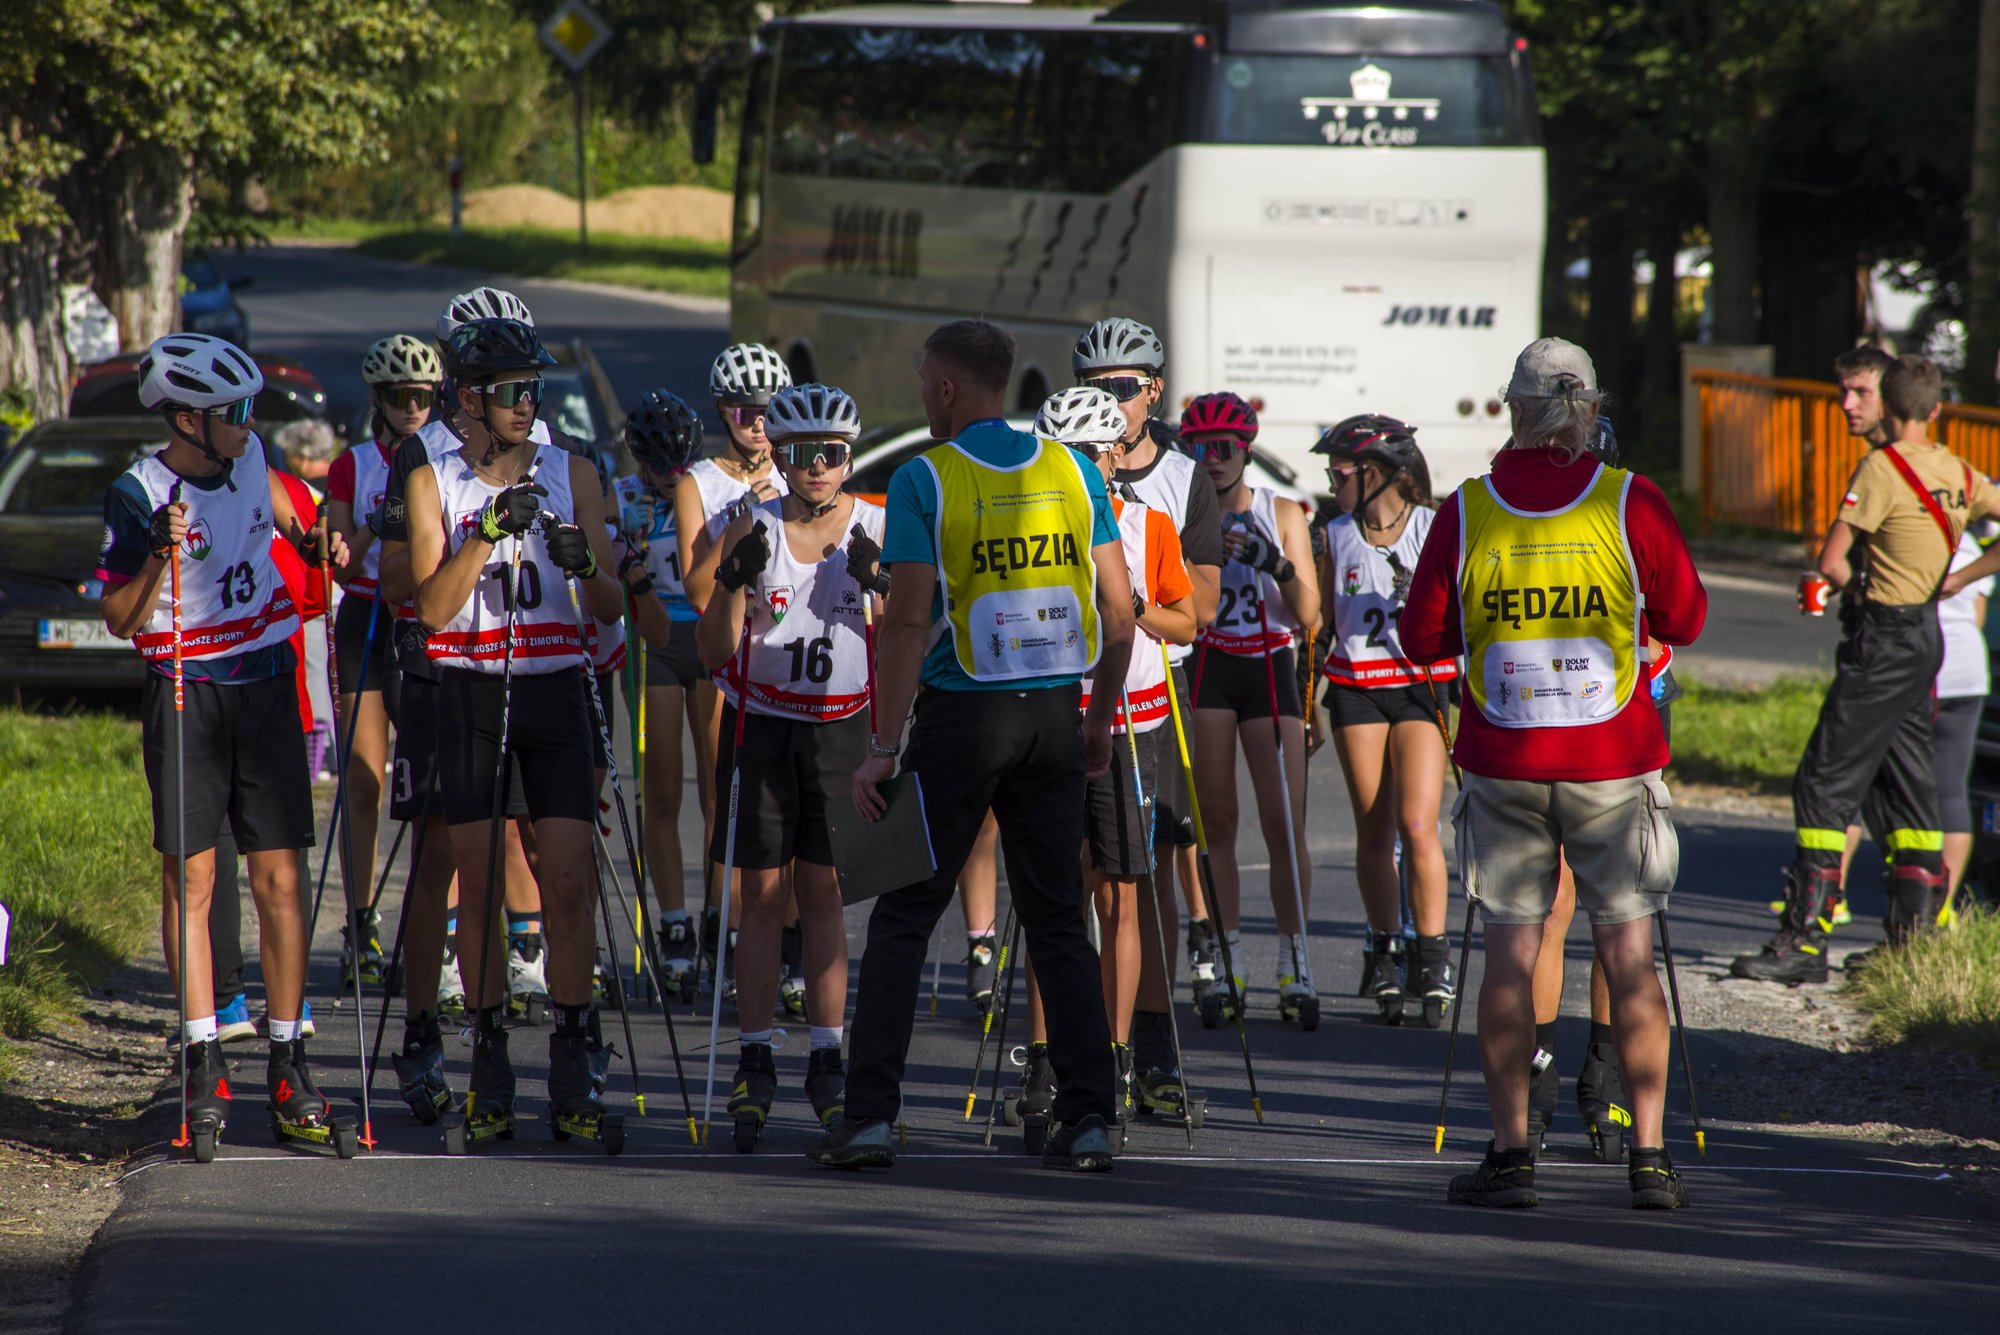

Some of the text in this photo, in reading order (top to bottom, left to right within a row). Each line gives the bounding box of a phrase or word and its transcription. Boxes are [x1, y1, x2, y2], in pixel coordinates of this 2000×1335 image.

[1383, 304, 1497, 328] JOMAR
[172, 361, 202, 375] SCOTT
[972, 533, 1080, 580] SĘDZIA
[216, 561, 257, 610] 13
[492, 560, 542, 610] 10
[1048, 606, 1068, 614] DOLNY
[1216, 584, 1261, 628] 23
[1482, 585, 1609, 630] SĘDZIA
[213, 631, 245, 643] SPORTY
[448, 641, 499, 654] KARKONOSZE
[529, 634, 565, 647] ZIMOWE
[783, 637, 833, 684] 16
[1565, 657, 1590, 665] DOLNY
[1565, 664, 1589, 672] ŚLĄSK
[775, 699, 808, 712] SPORTY
[810, 704, 845, 713] ZIMOWE
